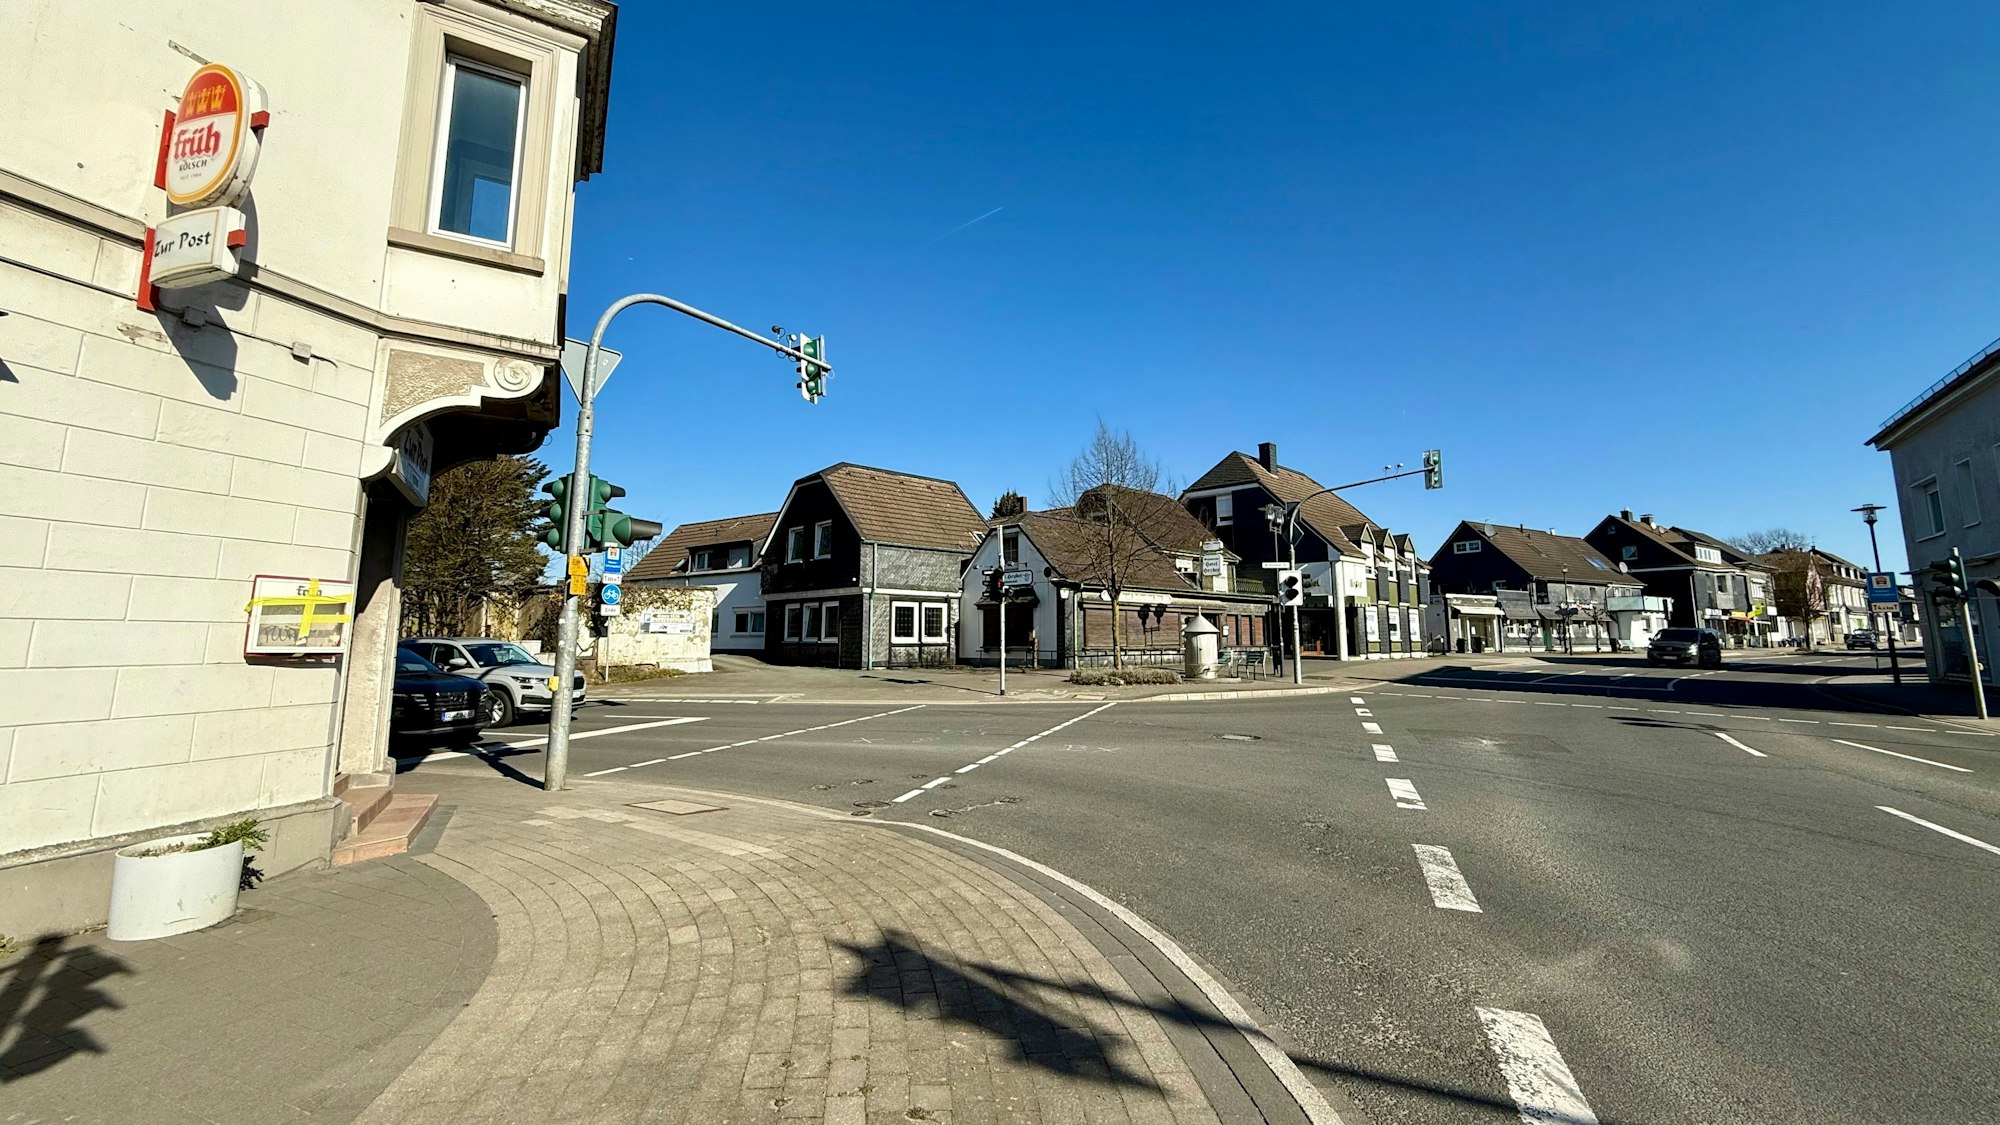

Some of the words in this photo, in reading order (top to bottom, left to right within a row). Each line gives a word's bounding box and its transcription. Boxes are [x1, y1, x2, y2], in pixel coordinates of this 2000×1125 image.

[174, 121, 220, 160] früh
[179, 159, 207, 171] KÖLSCH
[154, 240, 175, 258] Zur
[179, 231, 212, 250] Post
